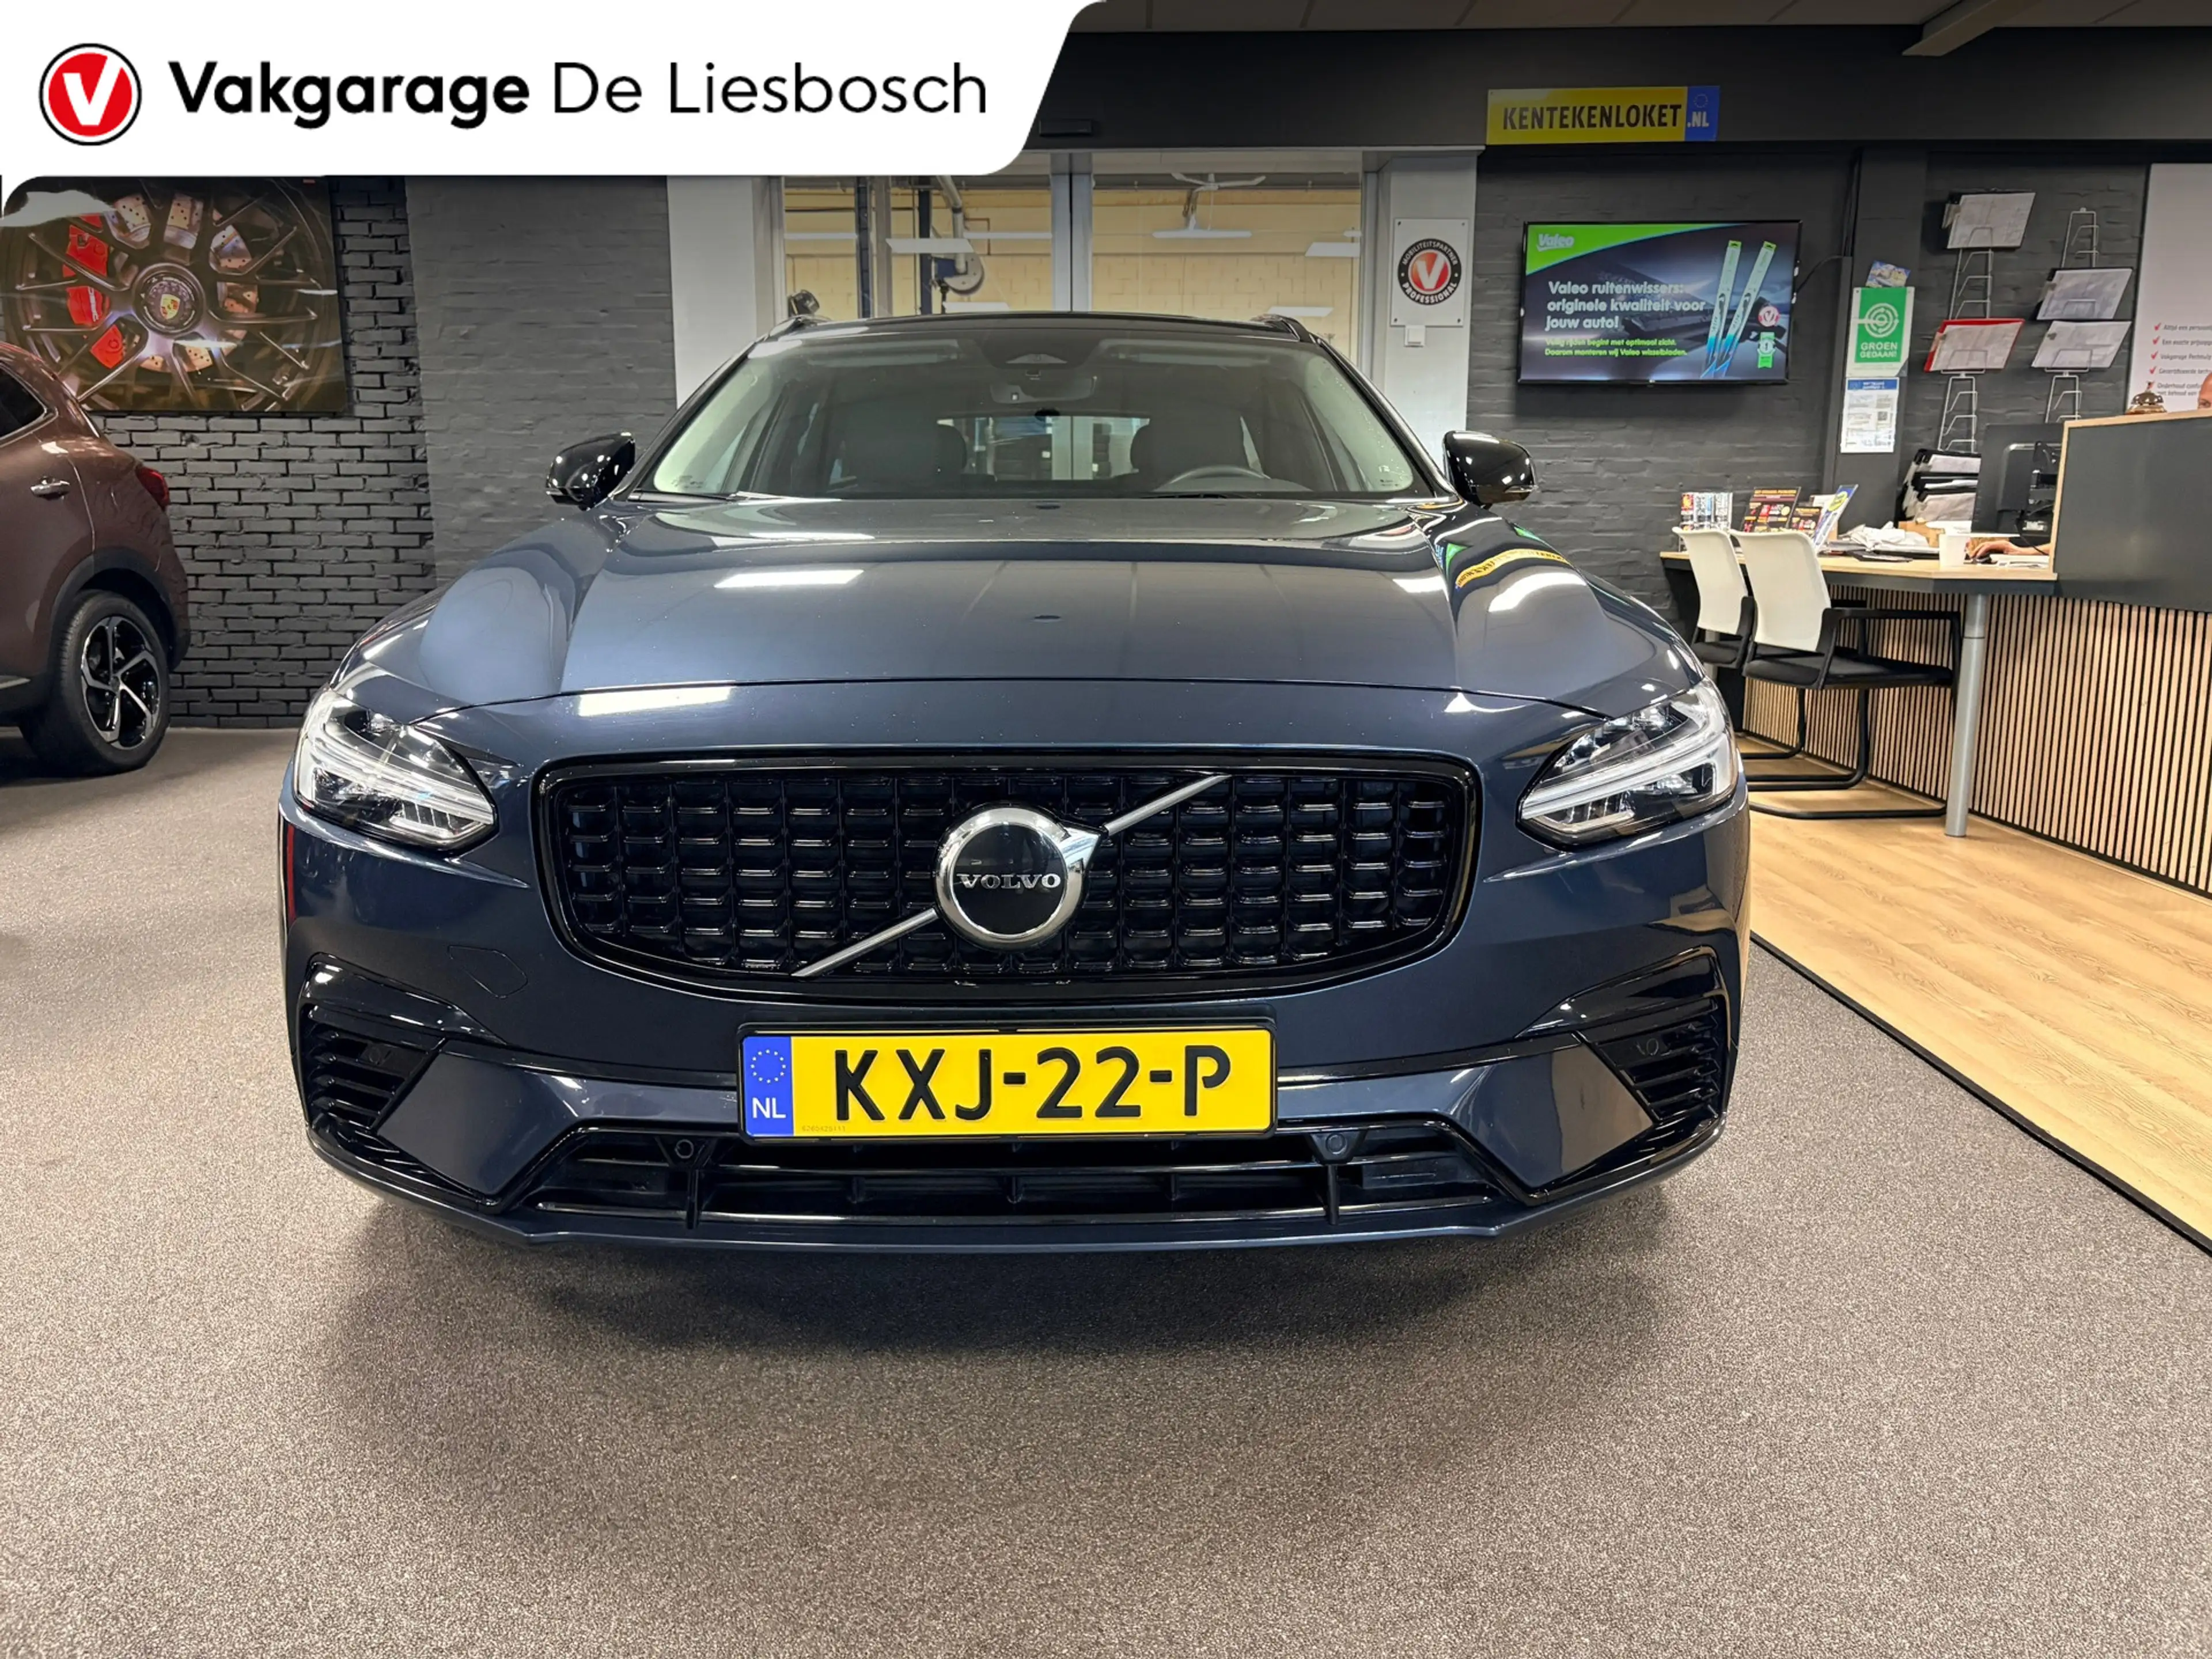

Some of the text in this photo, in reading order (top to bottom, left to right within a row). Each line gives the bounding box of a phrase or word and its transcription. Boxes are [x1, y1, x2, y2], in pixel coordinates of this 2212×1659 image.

[1503, 104, 1710, 130] KENTEKENLOKET .NL
[1538, 233, 1575, 248] Valeo
[1402, 282, 1457, 304] PROFESSIONAL
[1548, 281, 1683, 294] Valeo ruitenwissers:
[1547, 298, 1706, 314] originele kwaliteit voor
[1545, 316, 1619, 331] jouw auto!
[1861, 342, 1898, 350] GROEN
[956, 873, 1061, 889] VOLVO
[835, 1046, 1230, 1120] KXJ-22-P
[752, 1097, 786, 1118] NL
